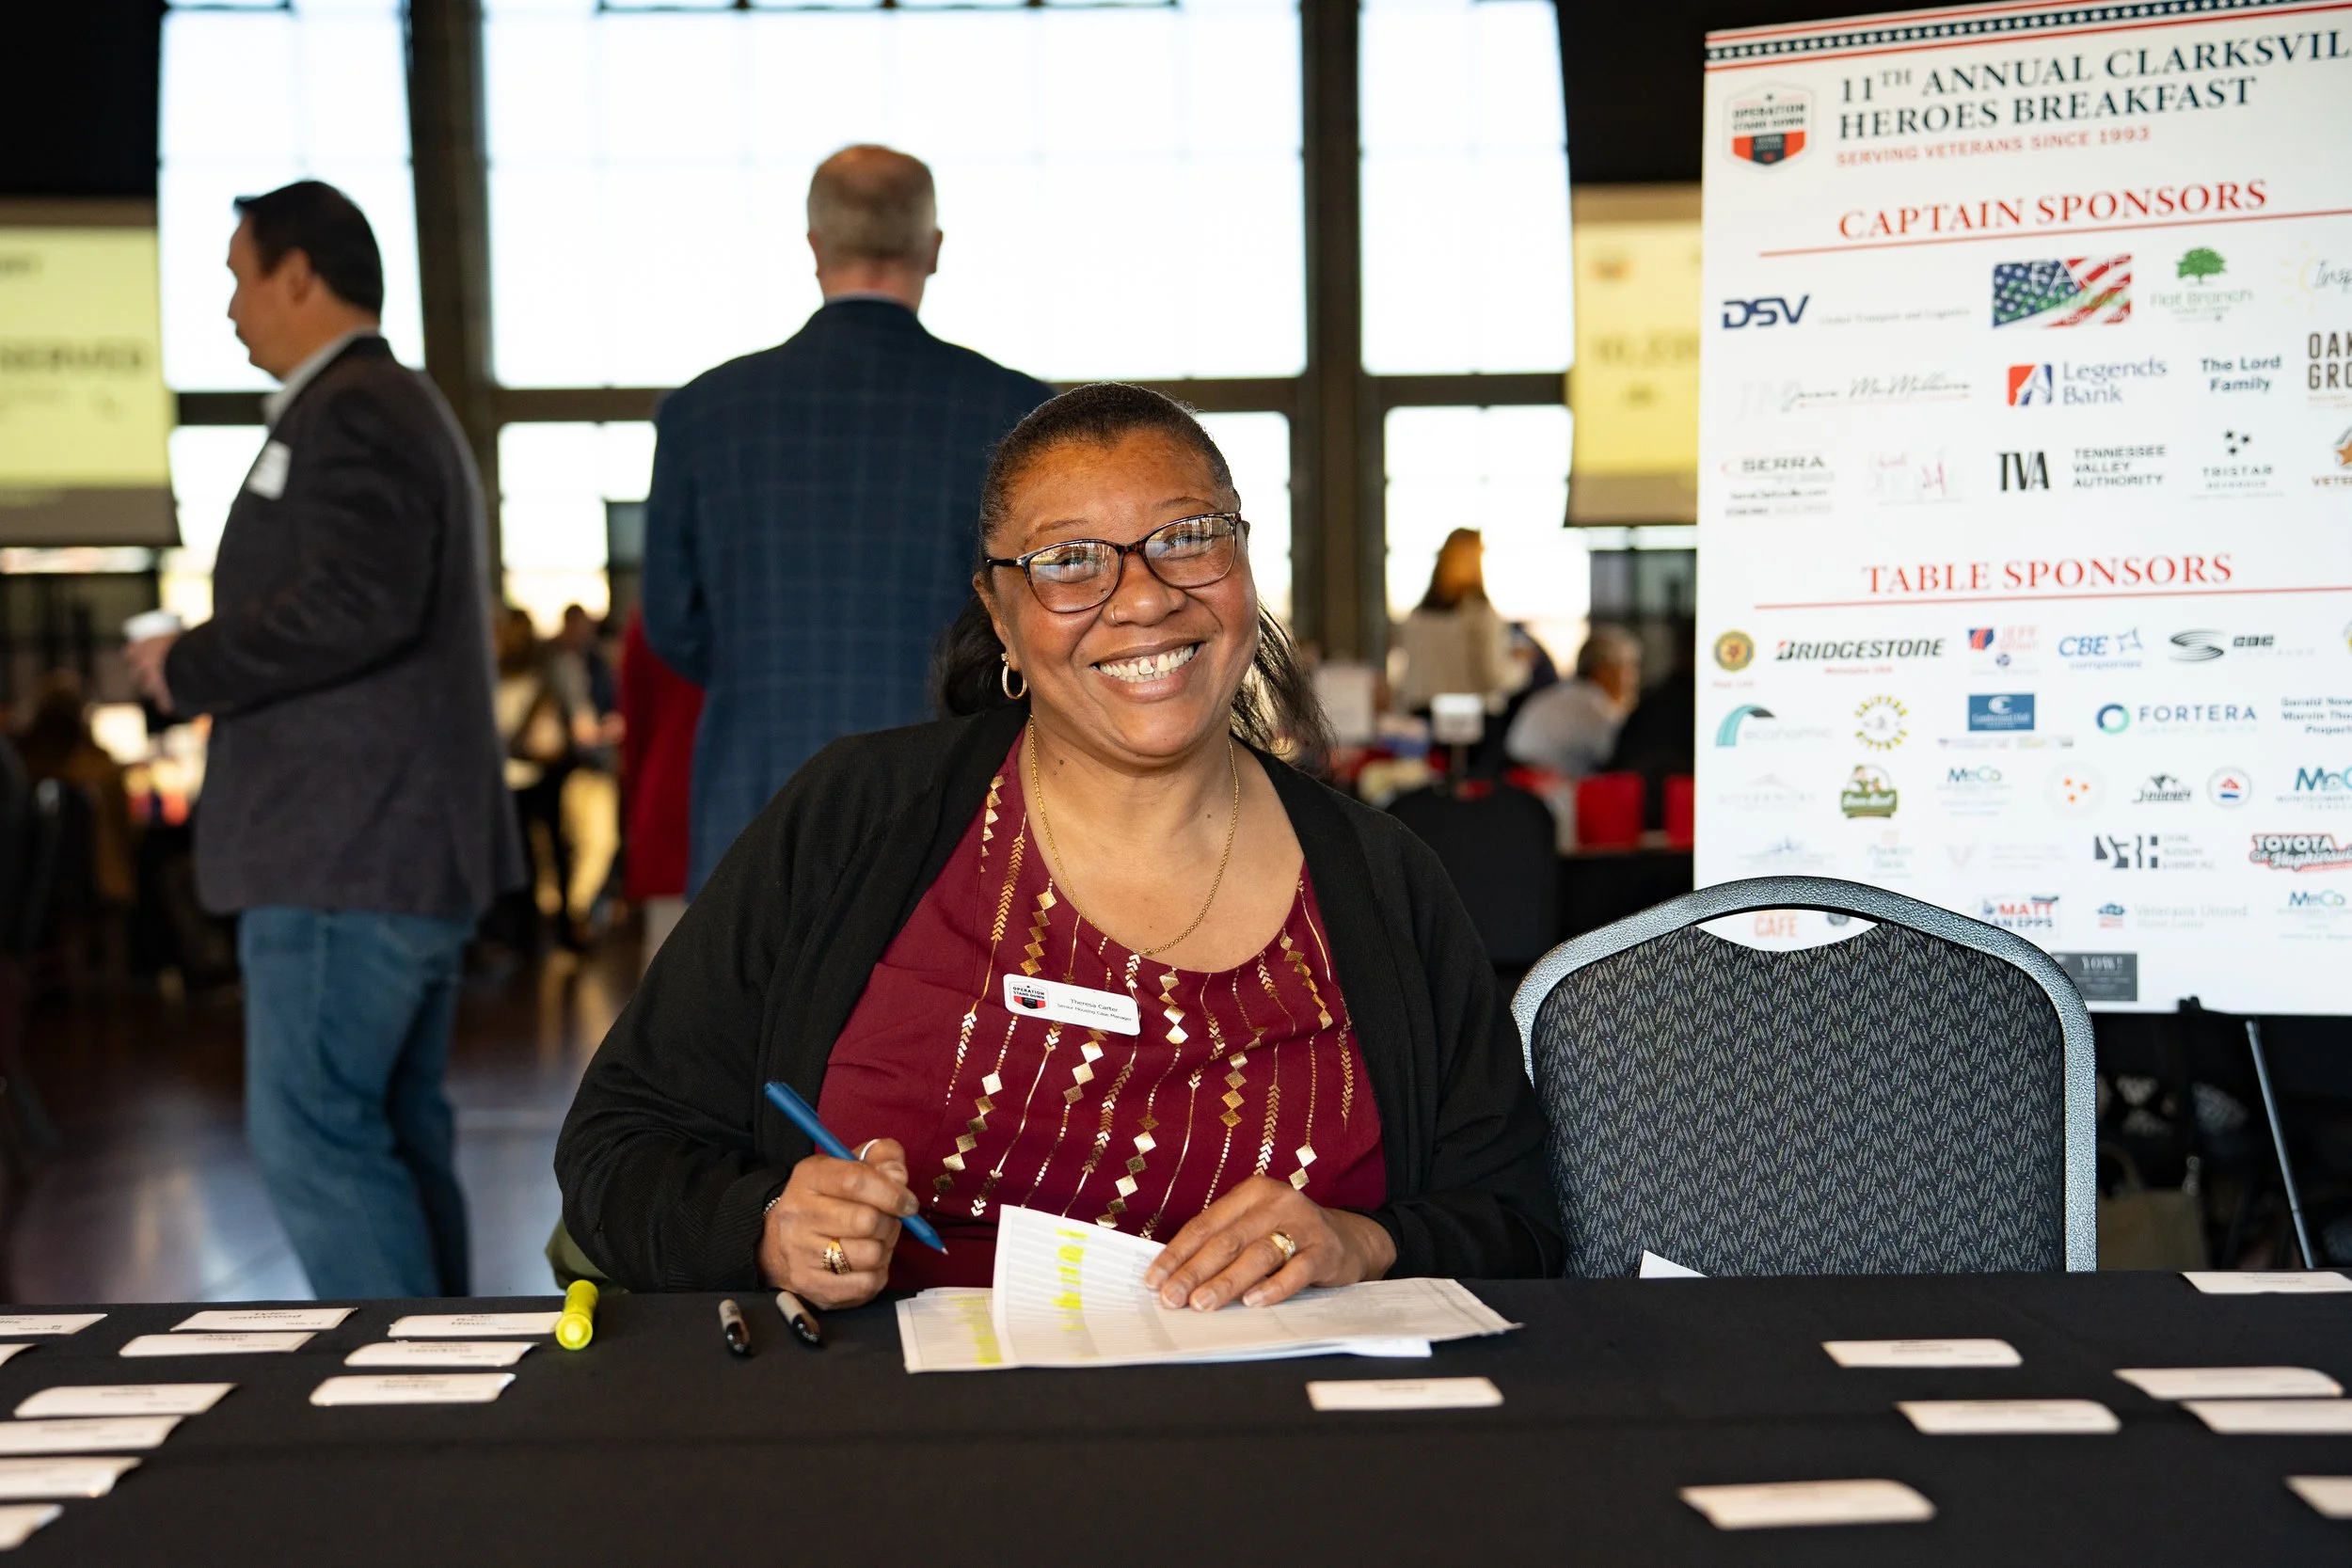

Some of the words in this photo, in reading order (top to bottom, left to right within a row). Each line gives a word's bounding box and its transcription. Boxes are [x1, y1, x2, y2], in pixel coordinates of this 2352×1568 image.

[1922, 54, 2094, 97] ANNUAL
[2105, 28, 2352, 80] CLARKSVIL
[1733, 103, 1805, 119] OPERATION
[1839, 99, 1999, 140] HEROES
[2011, 75, 2257, 126] BREAKFAST
[1772, 116, 1805, 128] DOWN
[1836, 145, 1918, 166] SERVING
[1925, 135, 2024, 160] VETERANS
[2030, 129, 2090, 152] SINCE
[2099, 125, 2152, 146] 1993
[1838, 198, 2025, 241] CAPTAIN
[2035, 179, 2267, 226] SPONSORS
[2150, 290, 2182, 307] Flat
[2186, 287, 2255, 305] Branch
[1722, 293, 1810, 330] DSV
[2063, 356, 2168, 386] Legends
[2200, 357, 2234, 372] The
[2239, 354, 2281, 372] Lord
[2063, 384, 2123, 405] Bank
[2209, 377, 2272, 395] Family
[2074, 444, 2166, 459] TENNESSEE
[1741, 455, 1825, 473] SERRA
[1996, 451, 2050, 492] TVA
[2073, 461, 2130, 473] VALLEY
[2201, 465, 2274, 478] TRISTAR
[2072, 473, 2164, 489] AUTHORITY
[1861, 561, 1992, 594] TABLE
[2002, 551, 2233, 591] SPONSORS
[1774, 637, 1947, 661] BRIDGESTONE
[2058, 636, 2109, 657] CBE
[2068, 659, 2143, 672] companies
[2280, 697, 2323, 708] Gerald
[2138, 704, 2257, 723] FORTERA
[2280, 710, 2324, 721] Marvin
[1947, 765, 2003, 783] MeCo
[2254, 835, 2334, 852] TOYOTA
[2288, 890, 2345, 907] MeCo
[1999, 902, 2053, 915] MATT
[2134, 903, 2196, 919] Veterans
[2201, 902, 2249, 918] United
[1755, 913, 1798, 939] CAFE
[1012, 986, 1045, 996] OPERATION
[1057, 1003, 1073, 1011] Senior
[1075, 1006, 1096, 1016] Housing
[1110, 1012, 1133, 1022] Manager
[1070, 998, 1097, 1008] Theresa
[1098, 1003, 1119, 1012] Carter
